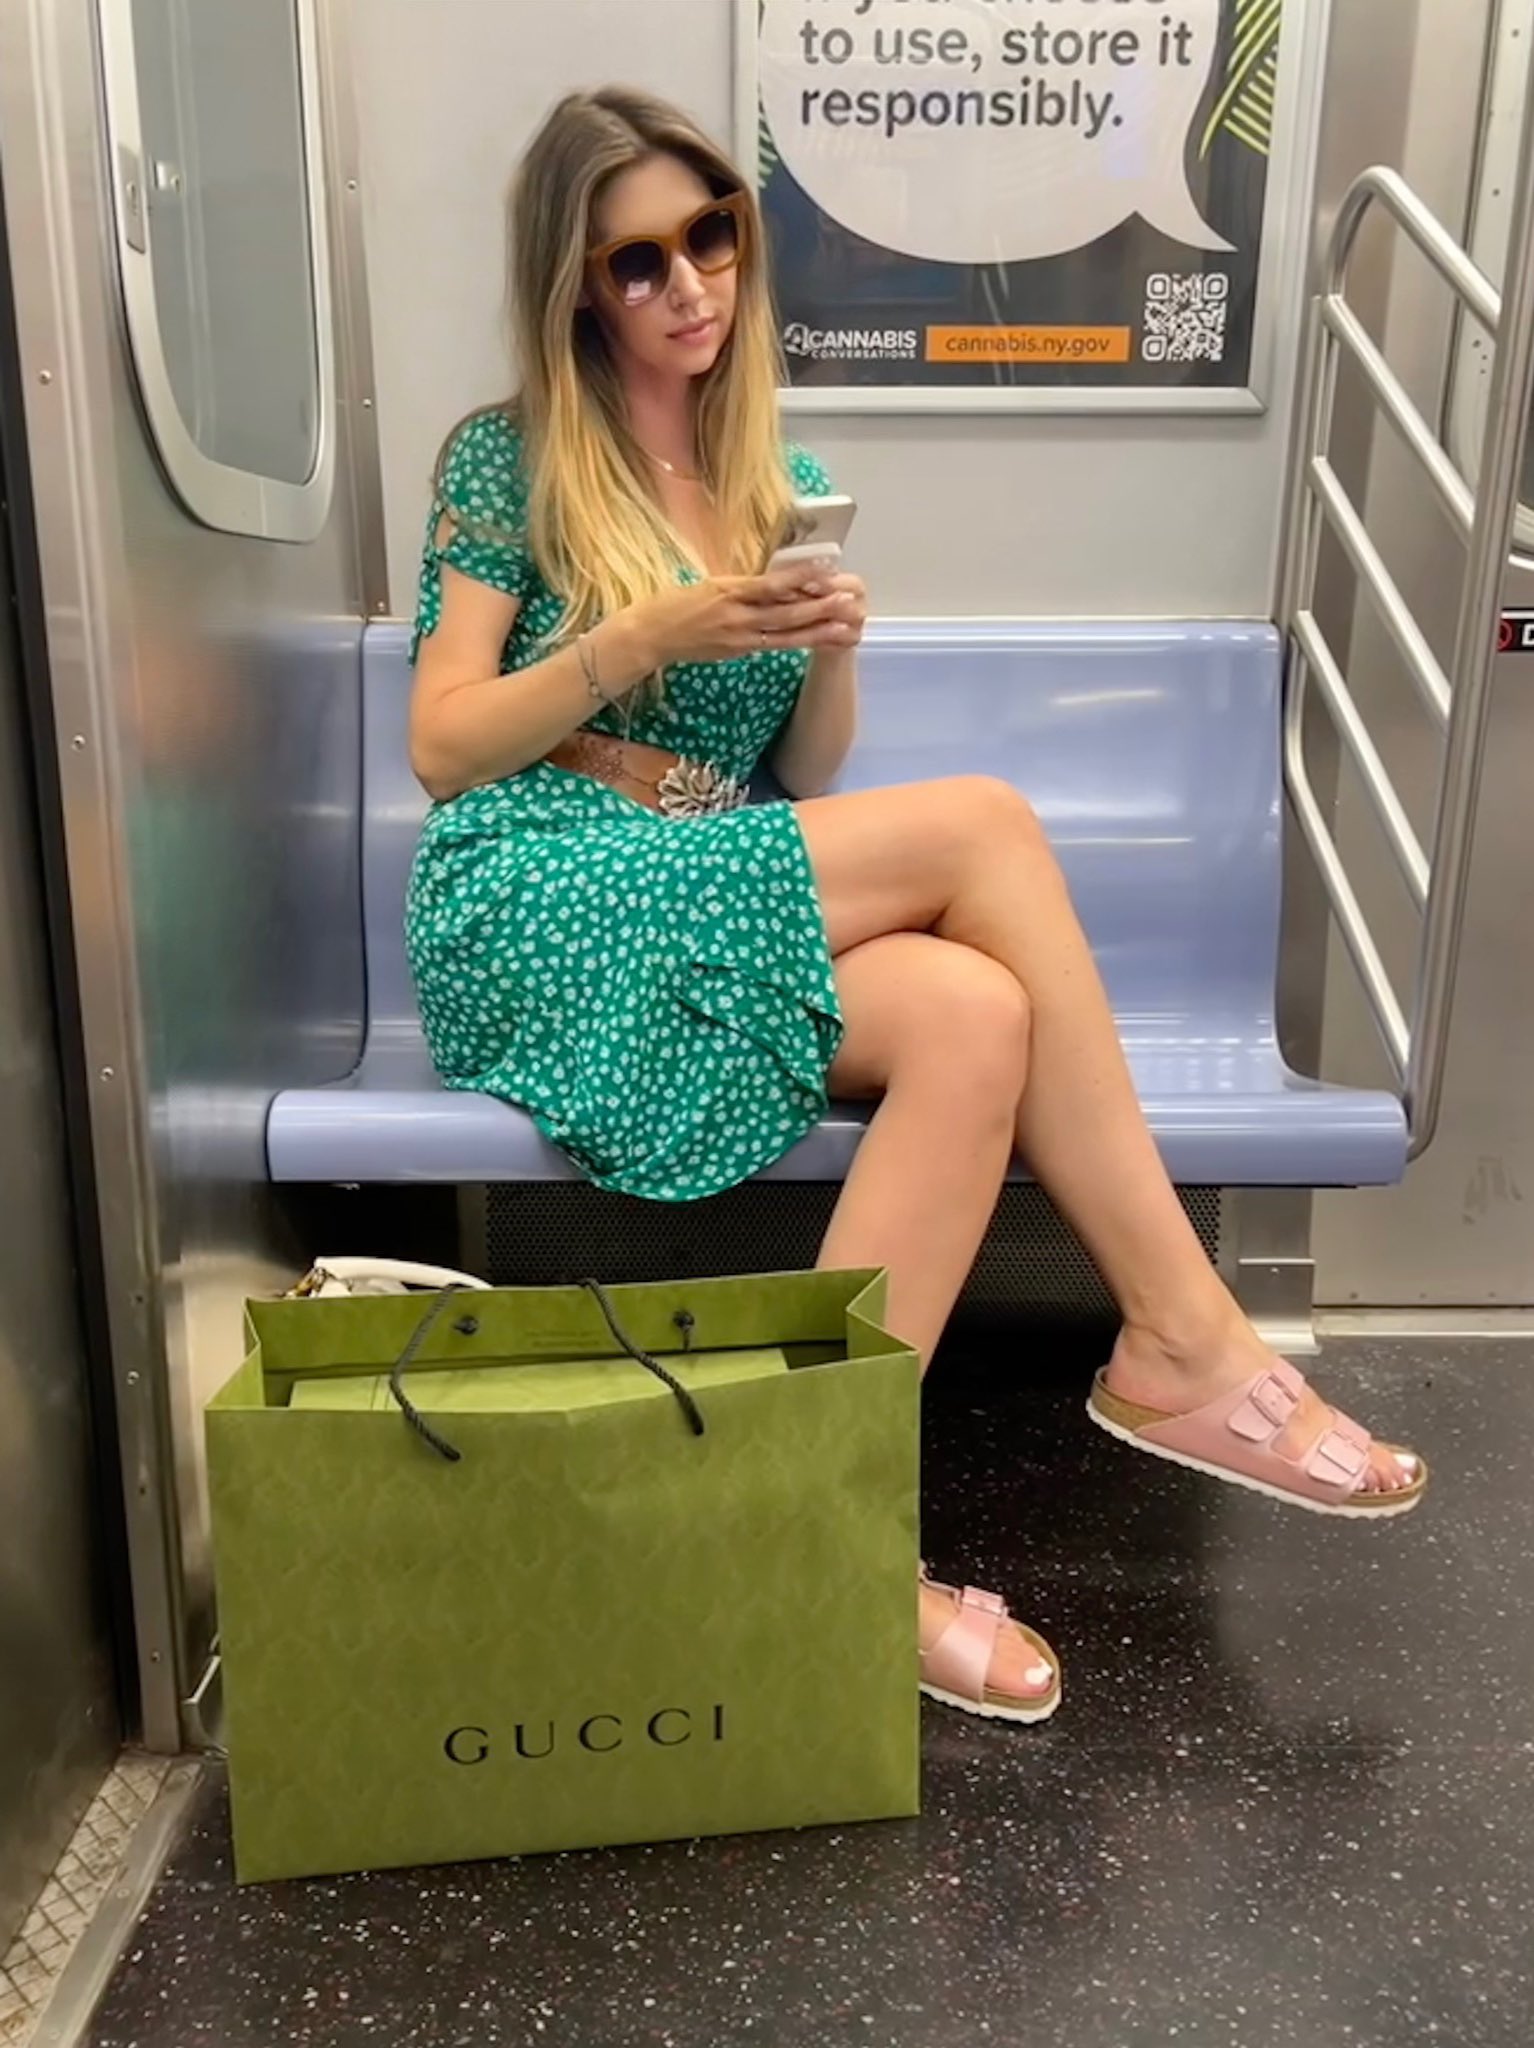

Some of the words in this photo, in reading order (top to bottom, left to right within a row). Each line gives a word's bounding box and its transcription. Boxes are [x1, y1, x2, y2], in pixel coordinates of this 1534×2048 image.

[799, 20, 854, 65] to
[874, 28, 983, 73] use,
[1001, 20, 1140, 66] store
[1158, 15, 1193, 66] it
[801, 76, 1123, 138] responsibly.
[808, 329, 917, 349] CANNABIS
[810, 349, 917, 359] CONVERSATIONS
[945, 332, 1110, 357] cannabis.ny.gov
[443, 1704, 724, 1766] GUCCI
